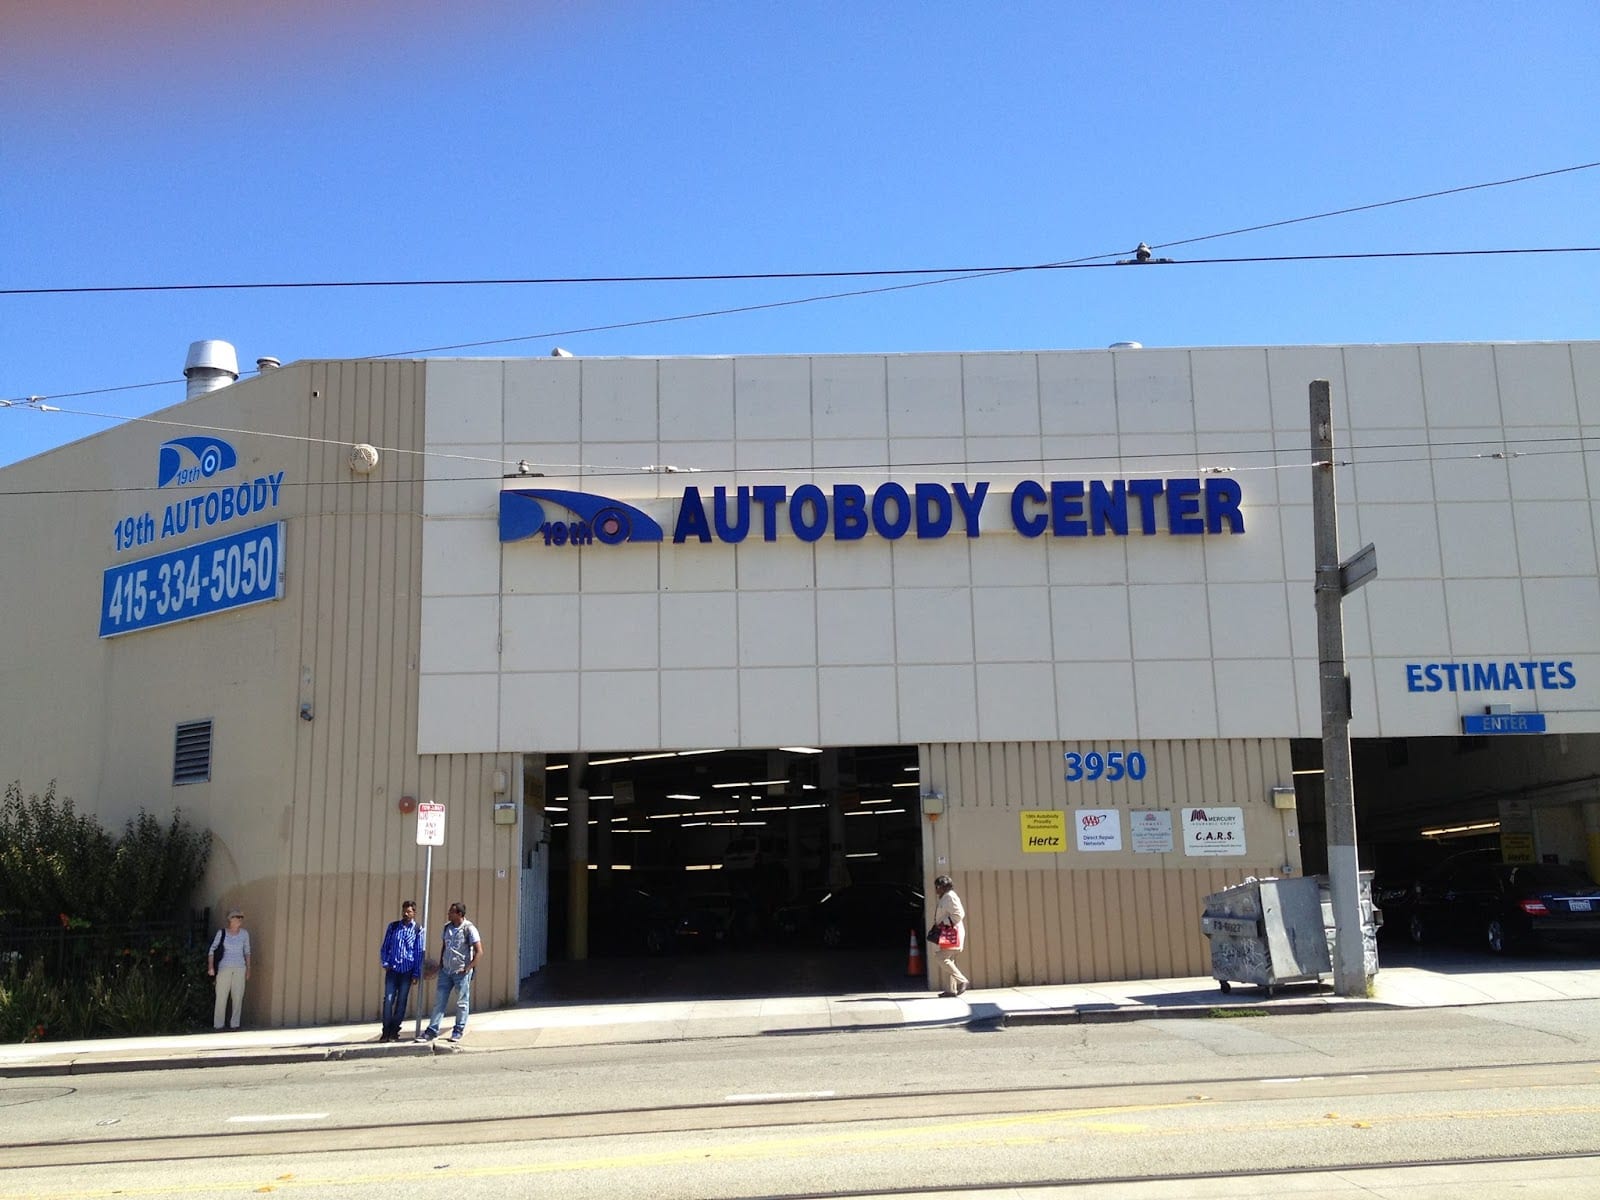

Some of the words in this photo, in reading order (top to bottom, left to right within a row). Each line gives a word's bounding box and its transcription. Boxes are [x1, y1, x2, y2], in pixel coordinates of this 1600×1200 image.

[176, 466, 200, 486] 19th
[114, 511, 155, 552] 19th
[161, 471, 284, 539] AUTOBODY
[673, 482, 990, 543] AUTOBODY
[1011, 478, 1245, 538] CENTER
[542, 521, 593, 546] 19th
[109, 536, 273, 625] 415-334-5050
[1406, 661, 1576, 692] ESTIMATES
[1482, 716, 1528, 731] ENTER
[1064, 751, 1147, 782] 3950
[1029, 836, 1059, 846] Hertz
[1195, 831, 1235, 841] C.A.R.S.
